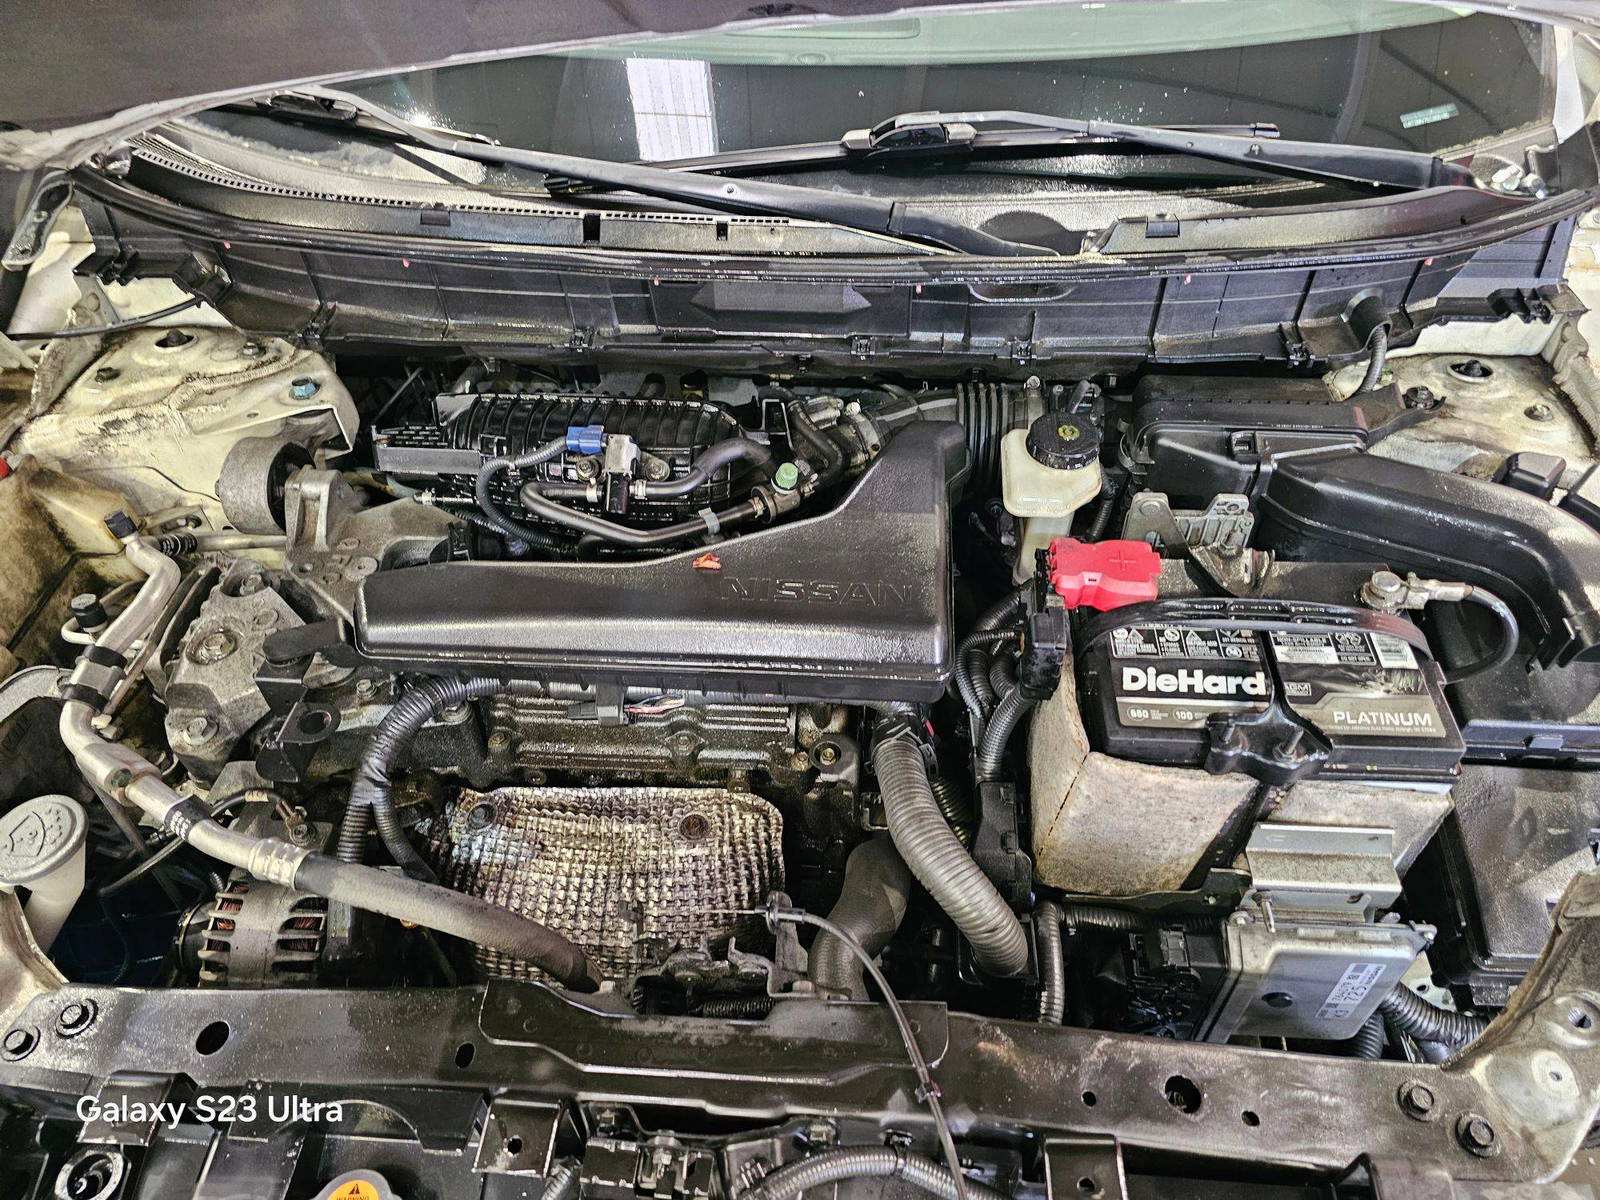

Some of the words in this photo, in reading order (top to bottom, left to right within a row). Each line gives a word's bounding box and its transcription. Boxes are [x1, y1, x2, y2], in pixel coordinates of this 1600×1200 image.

[719, 576, 912, 606] NISSAN
[1122, 666, 1267, 695] DieHard
[1333, 711, 1432, 727] PLATINUM
